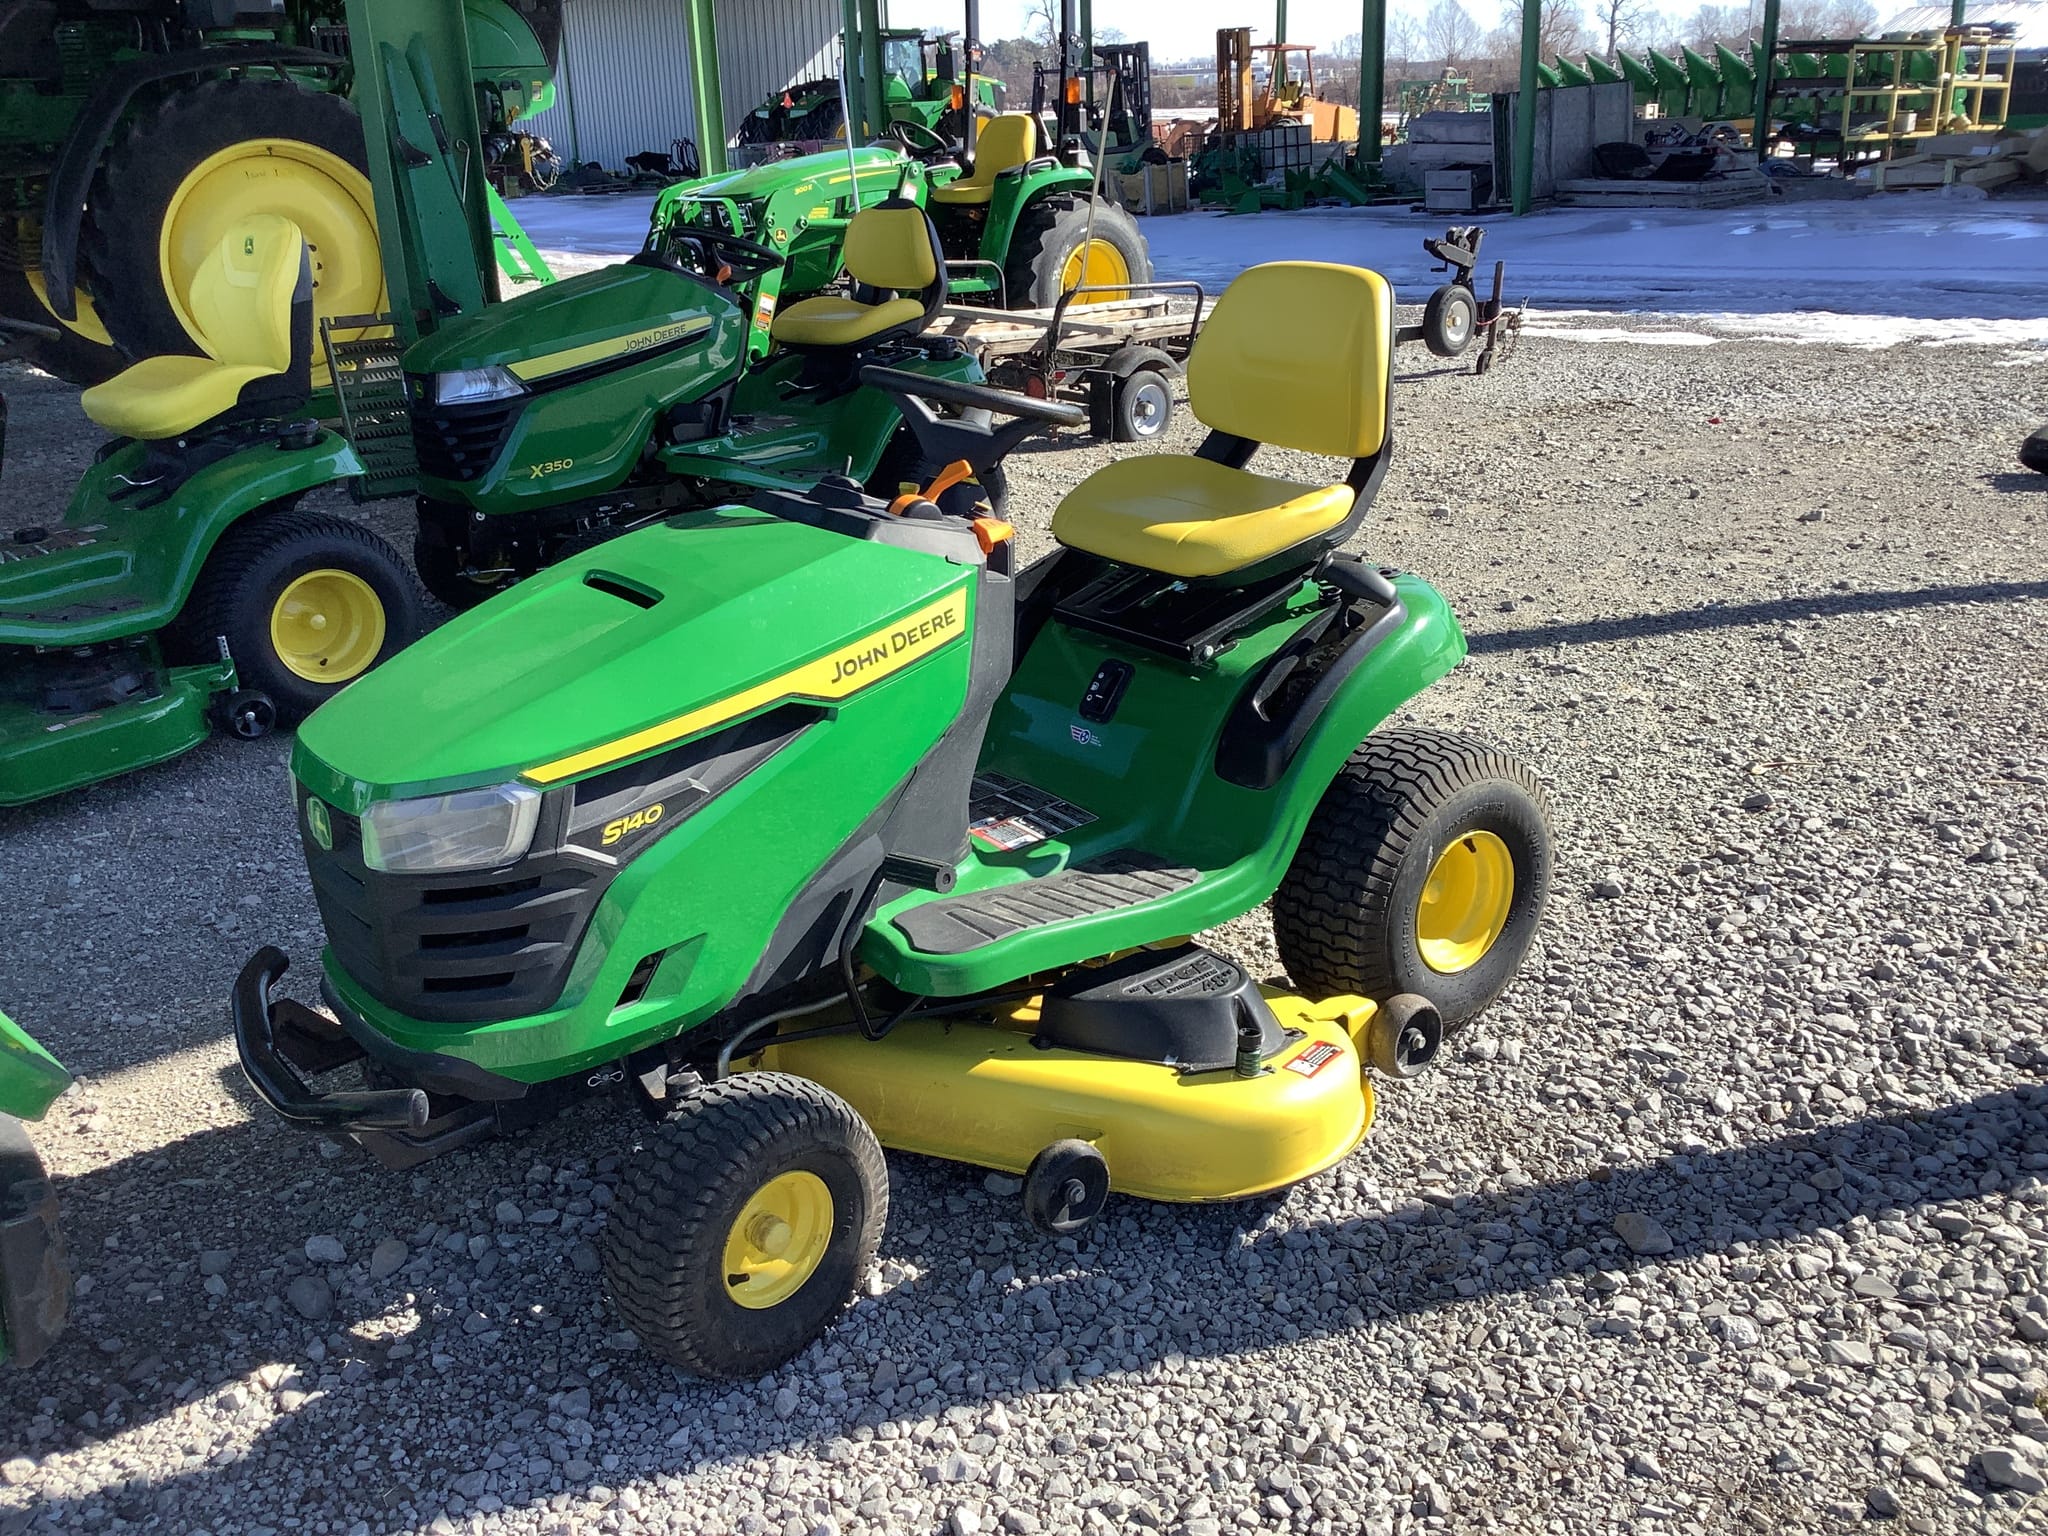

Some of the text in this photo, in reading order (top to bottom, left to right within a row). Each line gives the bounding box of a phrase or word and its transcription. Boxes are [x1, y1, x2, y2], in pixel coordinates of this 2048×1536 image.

[624, 324, 686, 352] JOHN DEERE
[530, 458, 573, 479] X350
[831, 608, 956, 684] JOHN DEERE
[602, 804, 663, 845] S140
